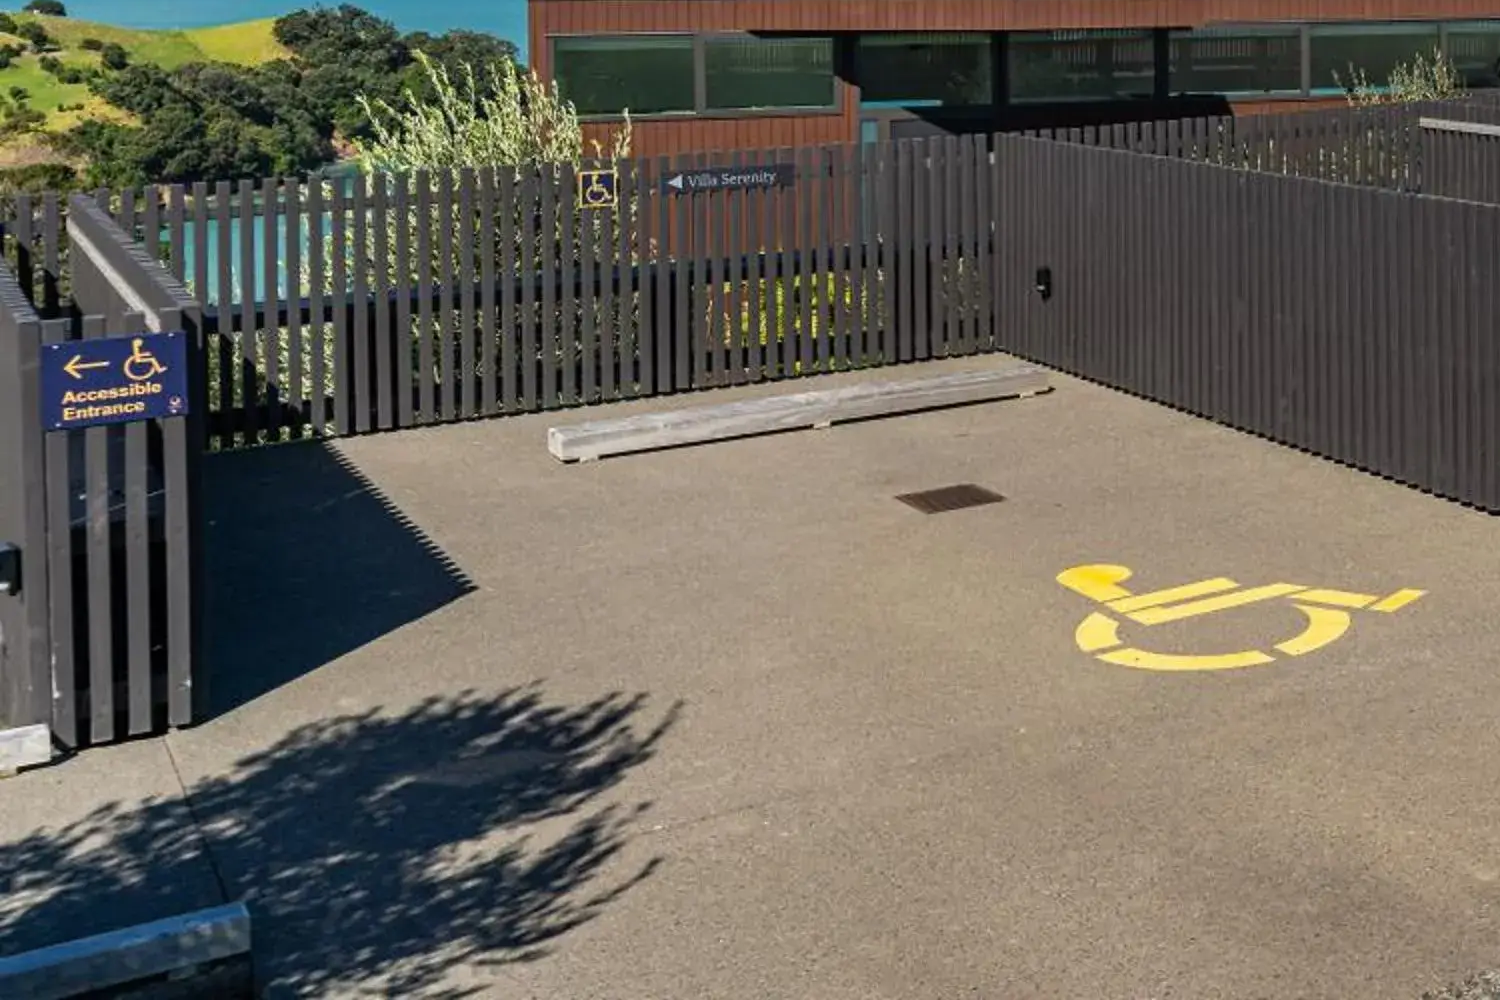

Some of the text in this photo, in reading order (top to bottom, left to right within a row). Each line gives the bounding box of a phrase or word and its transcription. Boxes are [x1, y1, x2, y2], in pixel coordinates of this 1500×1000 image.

[688, 171, 776, 187] Villa Serenity
[62, 382, 162, 404] Accessible
[62, 401, 145, 421] Entrance
